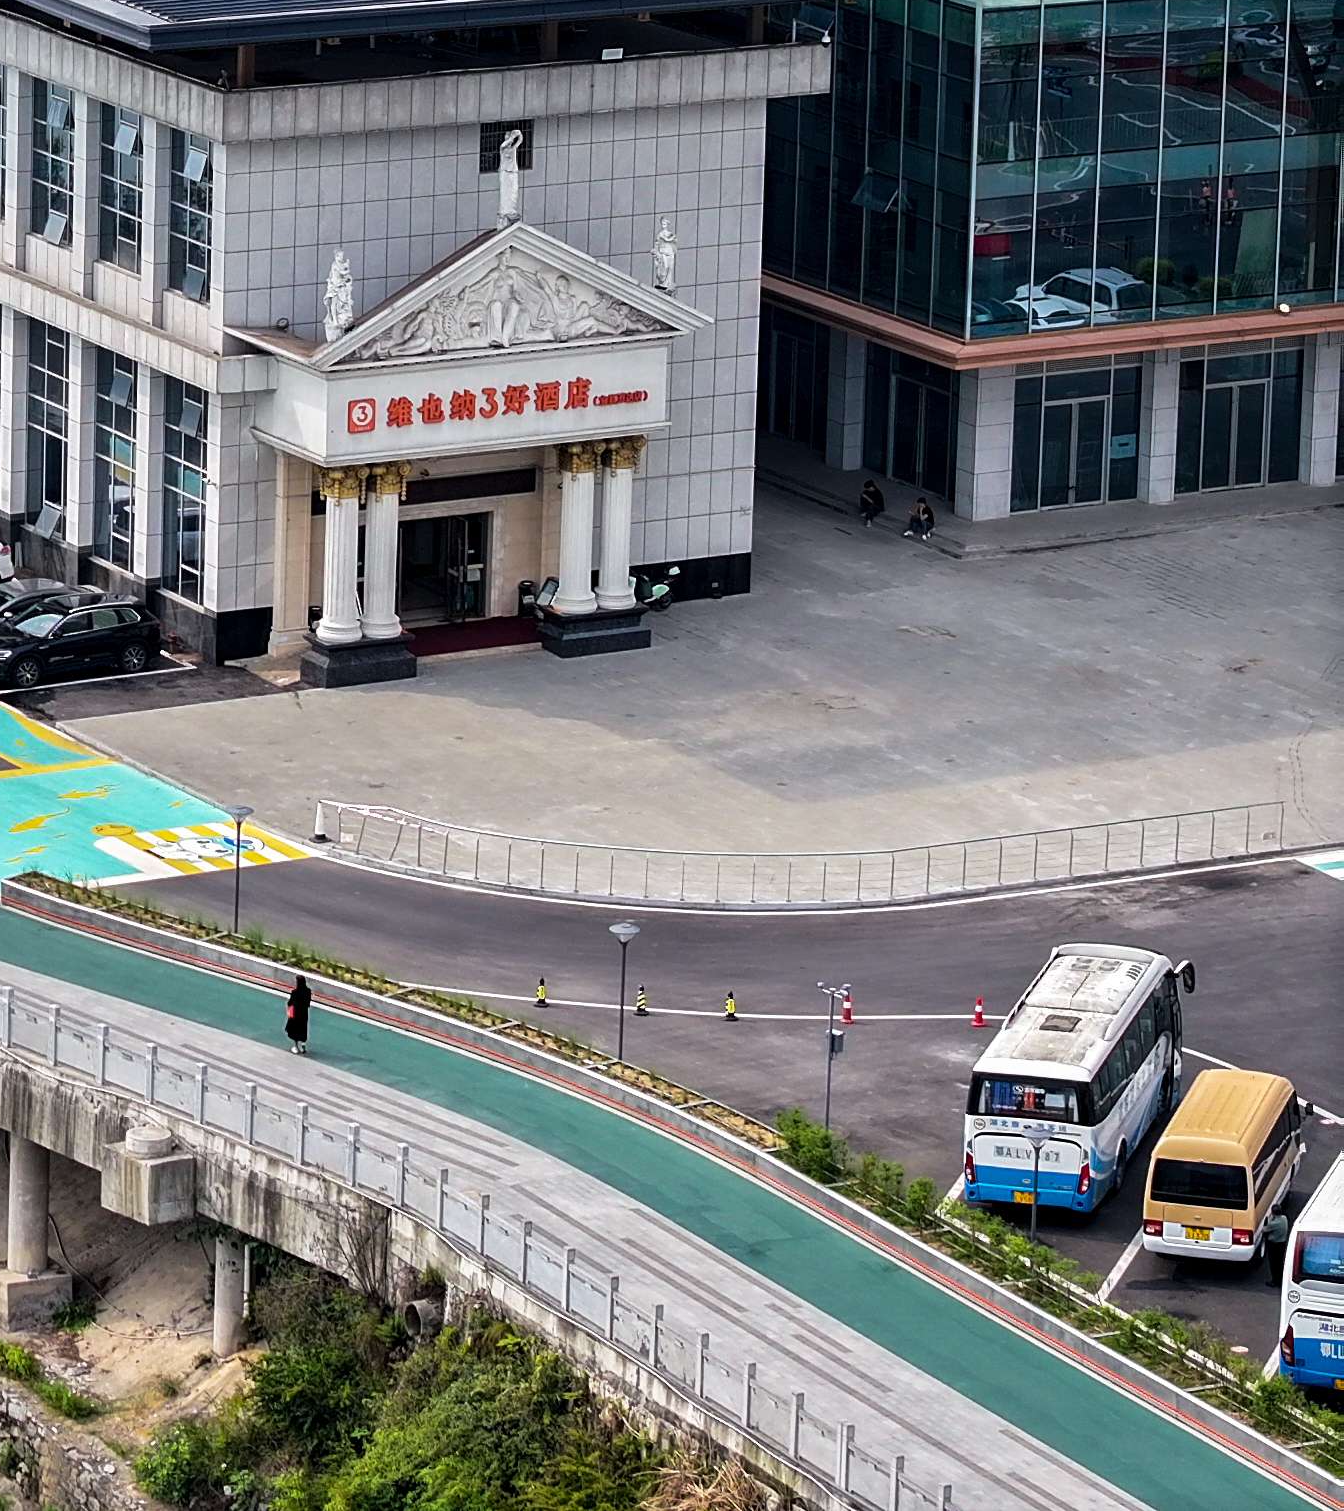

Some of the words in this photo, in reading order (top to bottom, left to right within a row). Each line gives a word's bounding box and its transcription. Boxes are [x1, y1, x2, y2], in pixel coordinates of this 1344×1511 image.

[386, 376, 593, 428] 维也纳3好酒店
